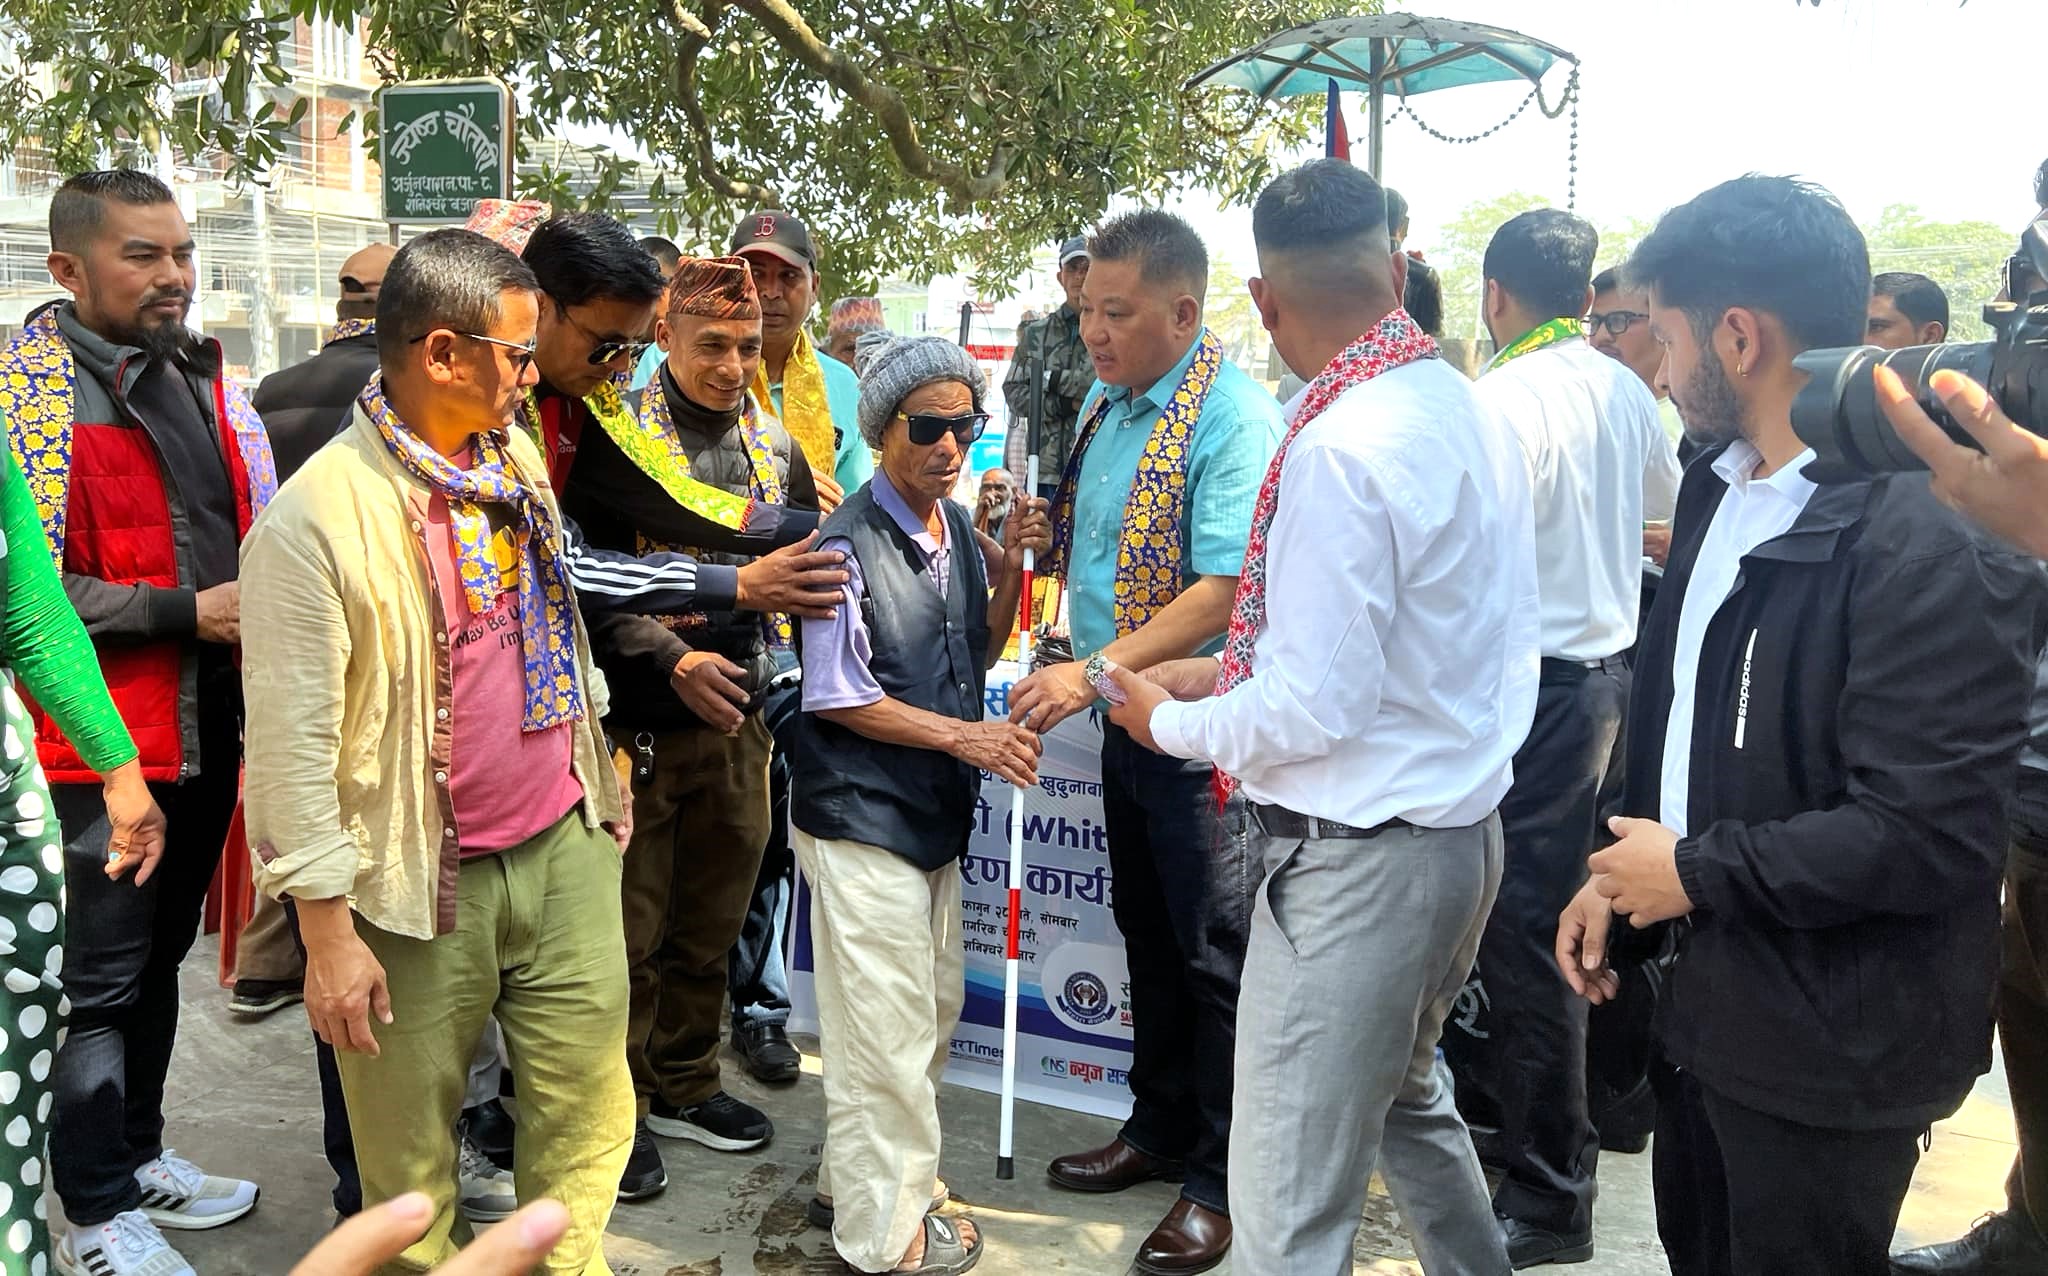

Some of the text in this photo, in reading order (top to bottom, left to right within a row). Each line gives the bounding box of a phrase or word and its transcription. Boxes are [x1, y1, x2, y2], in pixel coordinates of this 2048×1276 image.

[444, 101, 499, 174] चौतारी
[753, 215, 775, 237] B
[455, 625, 485, 649] May
[486, 614, 508, 634] Be
[1738, 660, 1751, 717] adidas
